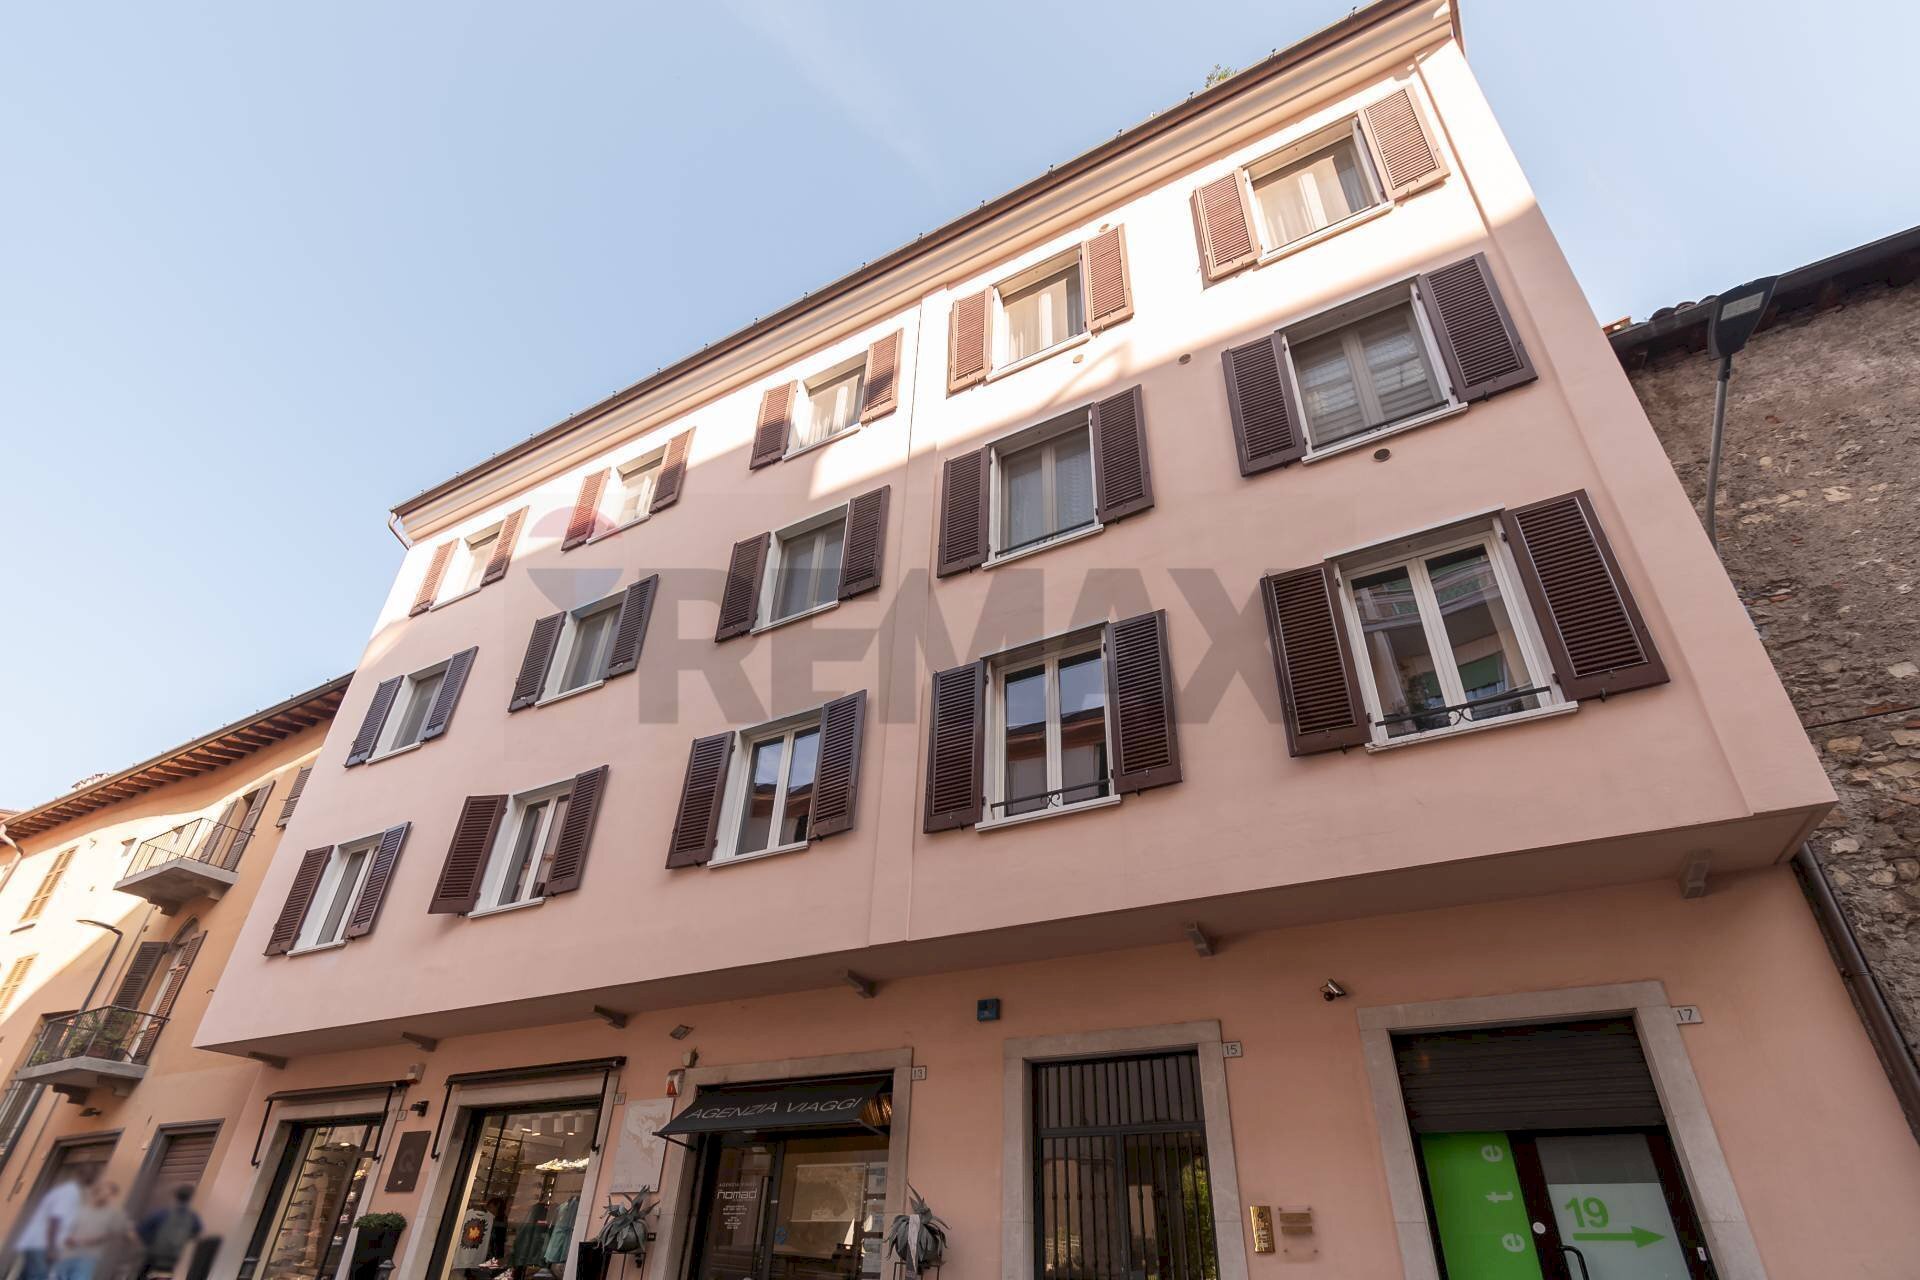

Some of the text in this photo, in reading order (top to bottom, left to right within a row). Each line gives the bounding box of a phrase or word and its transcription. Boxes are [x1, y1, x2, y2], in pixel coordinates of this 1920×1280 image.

[1676, 1008, 1693, 1021] 17
[1226, 1044, 1238, 1055] 15
[913, 1068, 923, 1078] 13
[686, 1096, 863, 1120] AGENZIA VIAGGI
[1564, 1196, 1609, 1229] 19
